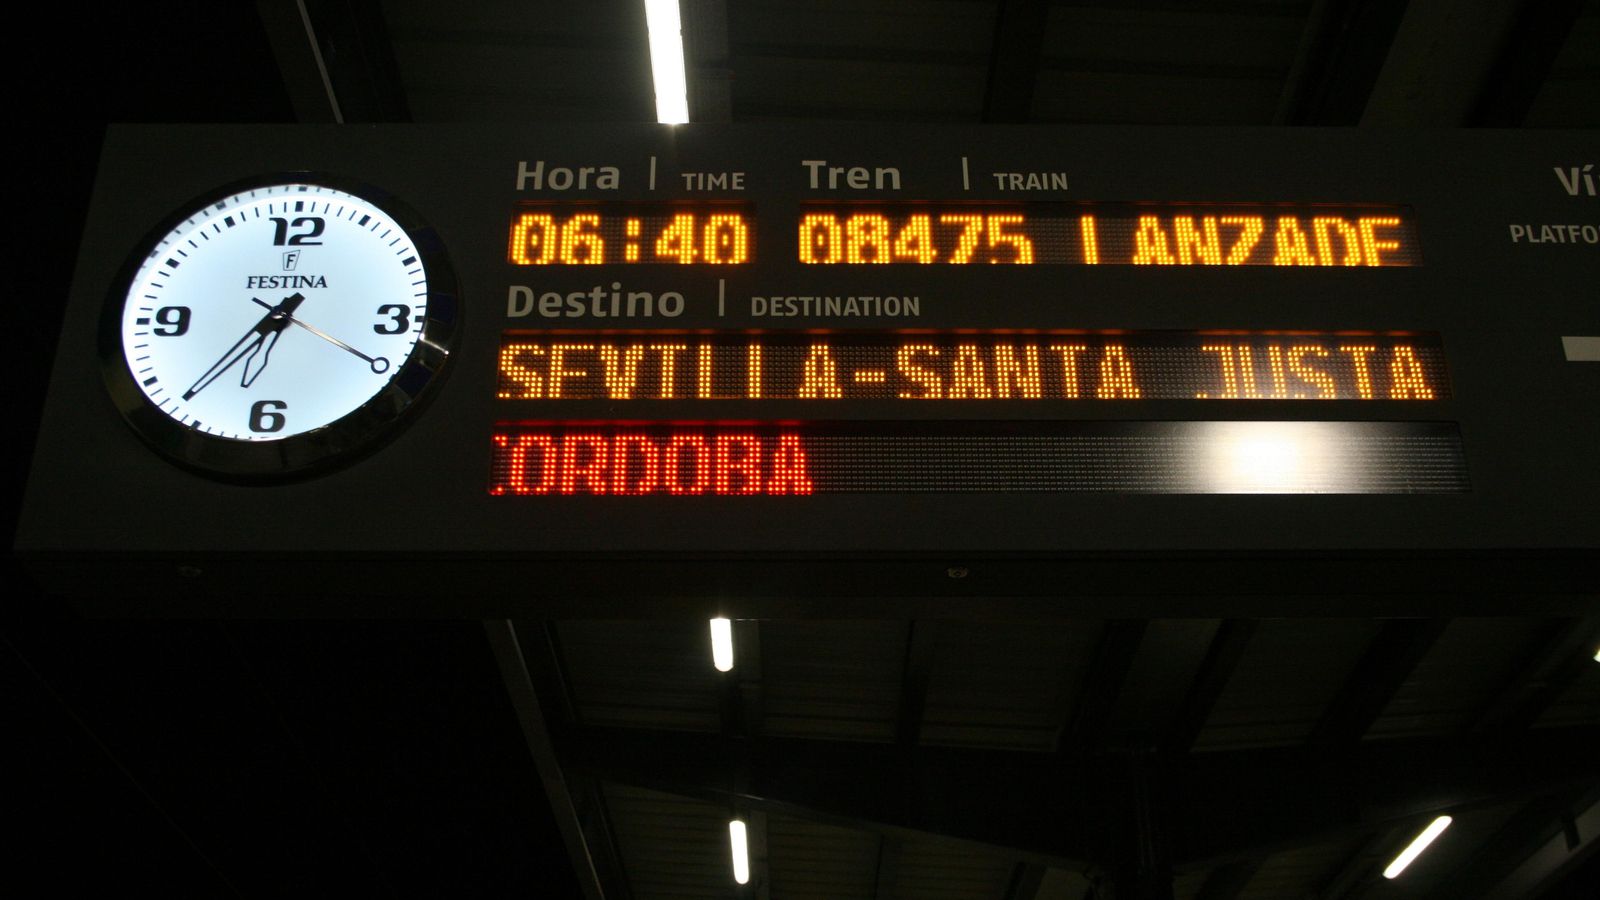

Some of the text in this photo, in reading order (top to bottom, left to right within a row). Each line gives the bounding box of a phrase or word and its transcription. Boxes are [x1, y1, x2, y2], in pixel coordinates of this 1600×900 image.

[516, 160, 745, 191] Hora TIME
[801, 160, 1068, 191] Tren TRAIN
[1553, 164, 1600, 196] Ví
[269, 217, 325, 246] 12
[512, 214, 747, 265] 06:40
[799, 214, 1035, 265] 08475
[1509, 224, 1600, 244] PLATFO
[246, 275, 328, 289] FESTINA
[507, 282, 921, 318] Destino DESTINATION
[153, 306, 192, 337] 9
[374, 304, 411, 335] 3
[248, 400, 288, 433] 6
